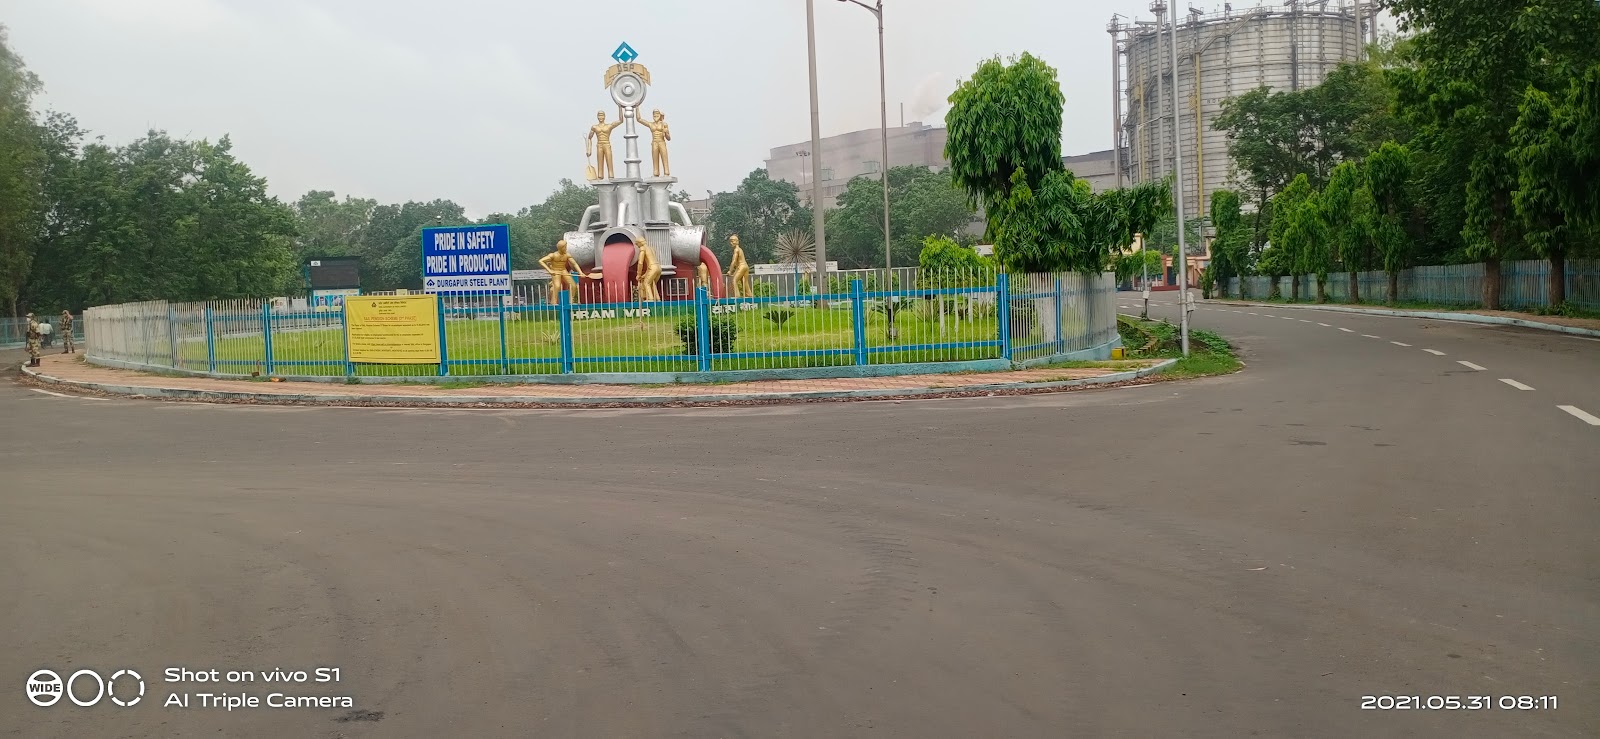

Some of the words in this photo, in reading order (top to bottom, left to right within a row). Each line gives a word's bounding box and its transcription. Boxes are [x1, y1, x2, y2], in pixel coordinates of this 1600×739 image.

[617, 63, 635, 73] DSP
[434, 232, 456, 251] PRIDE
[457, 232, 466, 250] IN
[467, 231, 495, 250] SAFETY
[426, 255, 448, 273] PRIDE
[449, 255, 457, 273] IN
[459, 253, 507, 272] PRODUCTION
[437, 279, 469, 288] DURGAPUR
[469, 278, 488, 287] STEEL
[489, 278, 508, 287] PLANT
[571, 309, 616, 320] HRAM
[623, 308, 651, 318] VIR
